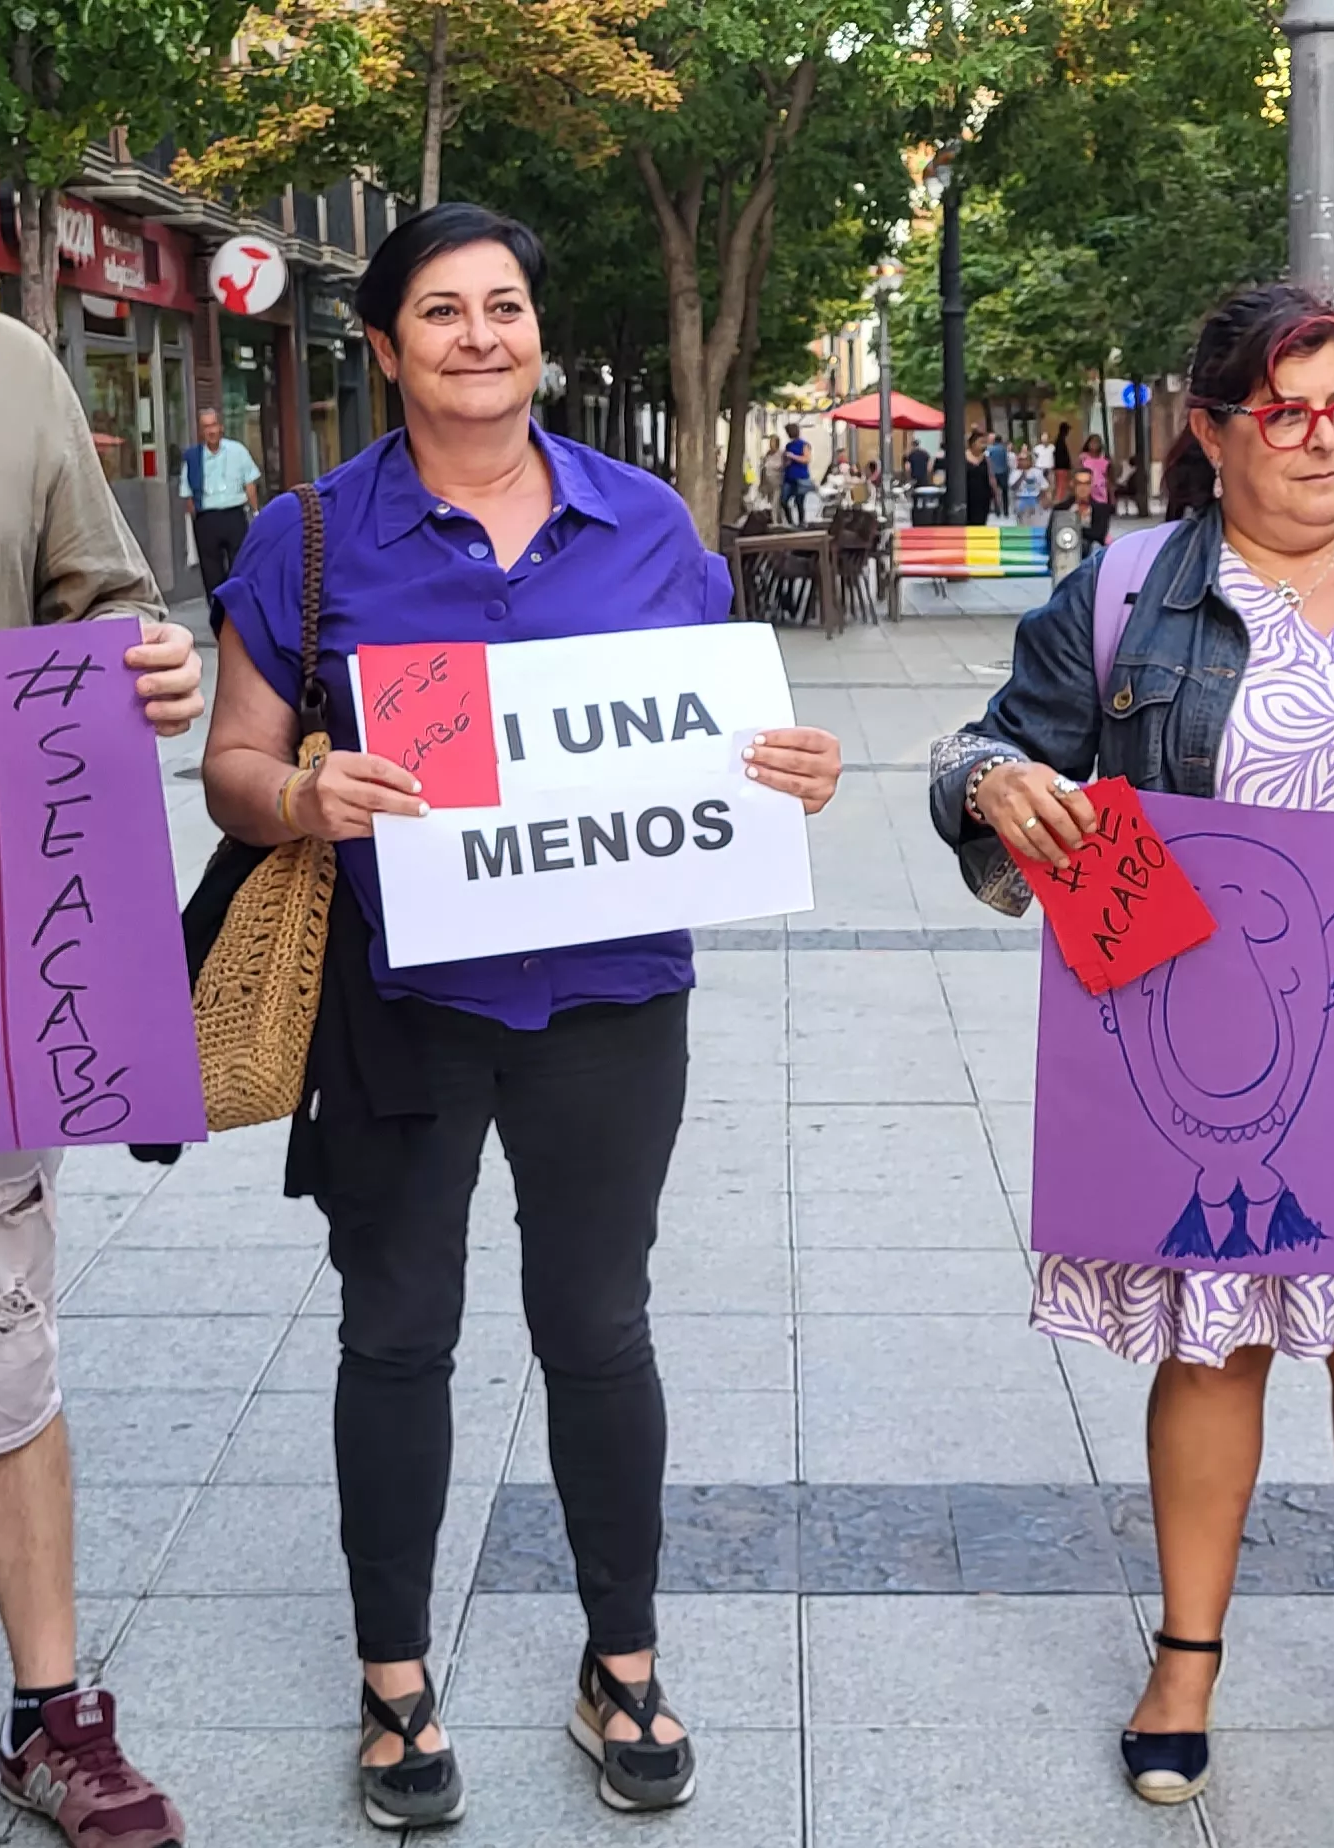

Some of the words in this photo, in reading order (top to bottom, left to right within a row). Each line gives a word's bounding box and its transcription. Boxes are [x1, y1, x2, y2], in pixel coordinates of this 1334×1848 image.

[372, 651, 449, 723] #SE
[401, 691, 471, 773] CABÓ
[503, 712, 526, 762] I
[552, 691, 723, 755] UNA
[461, 799, 735, 881] MENOS
